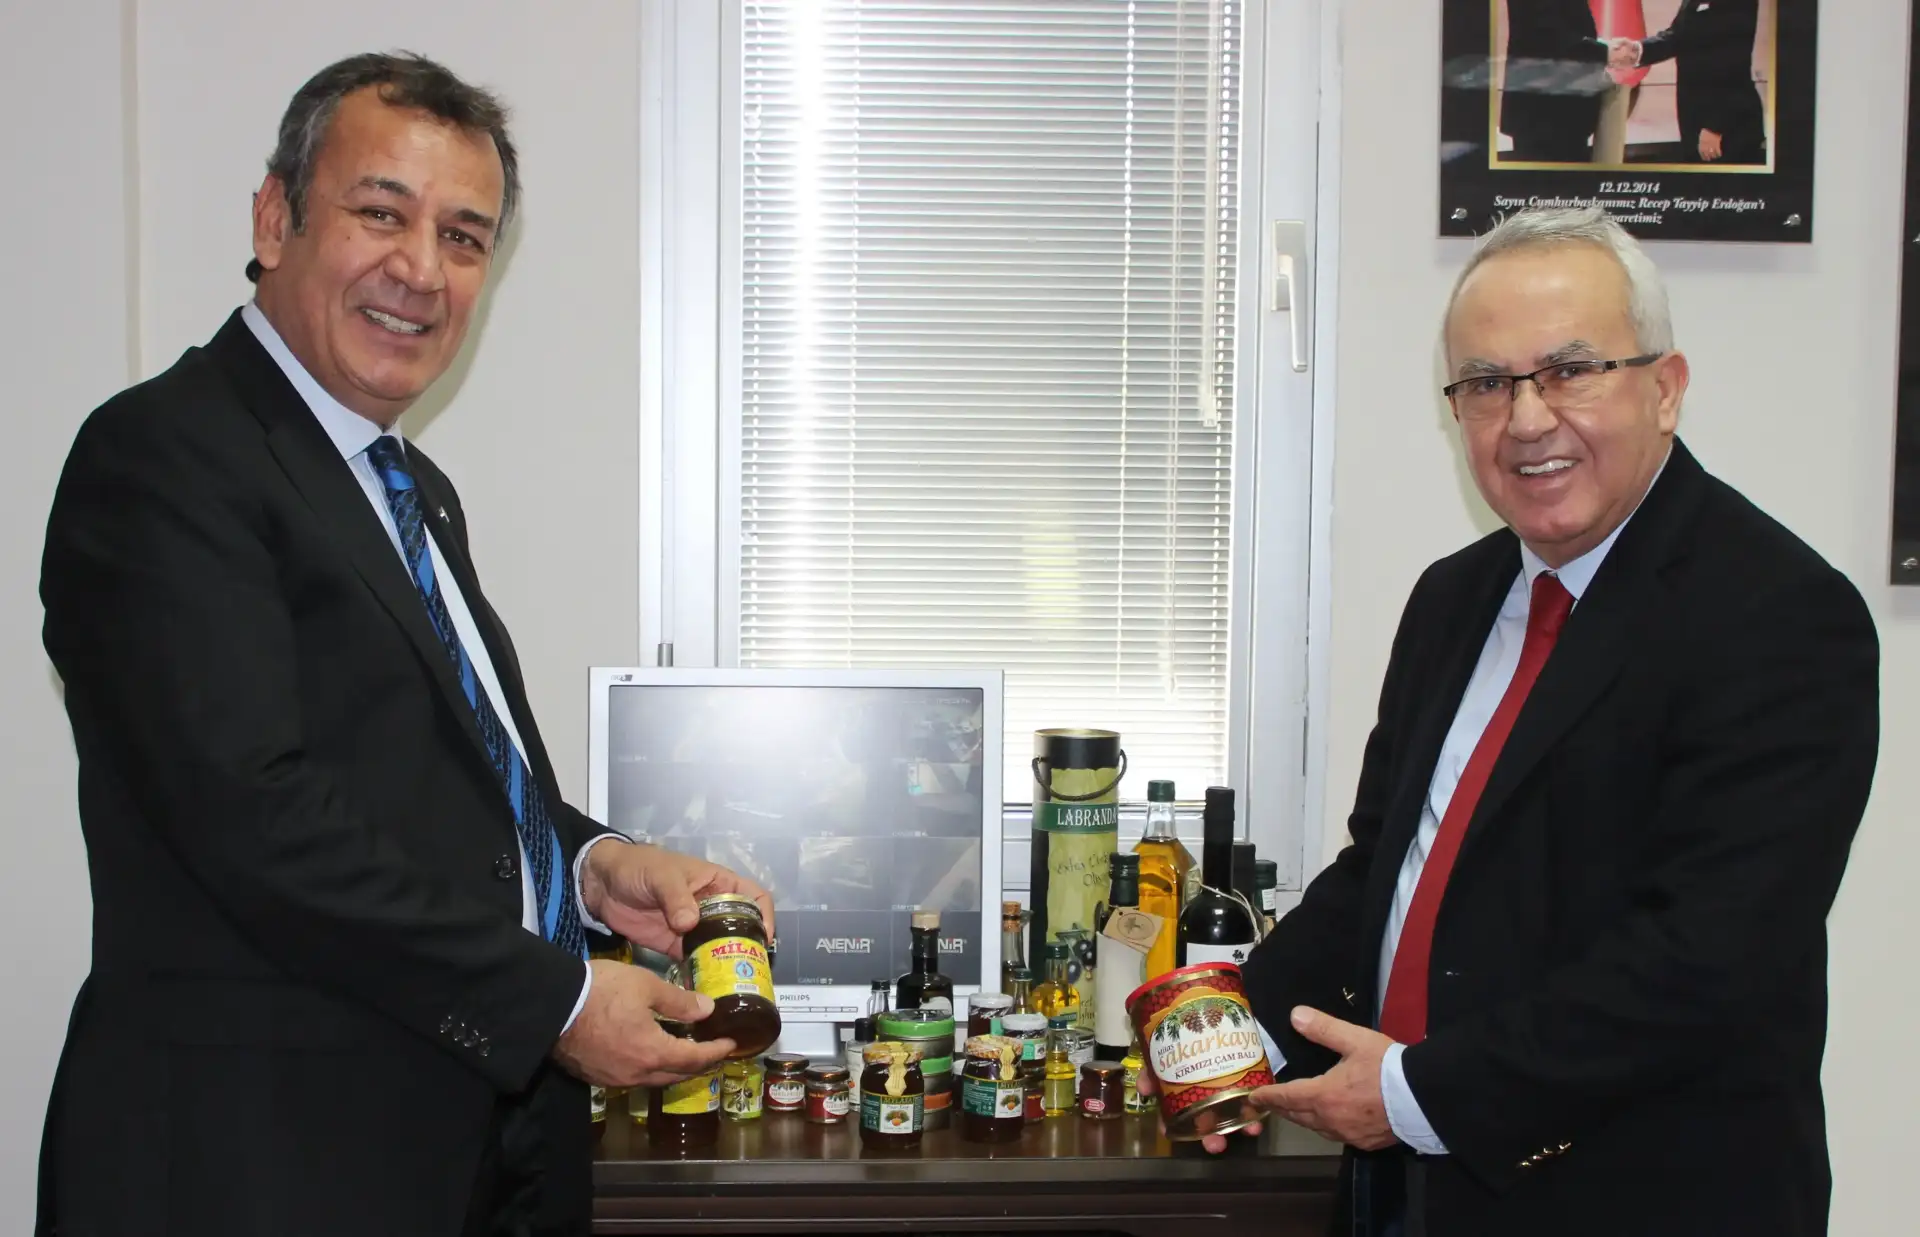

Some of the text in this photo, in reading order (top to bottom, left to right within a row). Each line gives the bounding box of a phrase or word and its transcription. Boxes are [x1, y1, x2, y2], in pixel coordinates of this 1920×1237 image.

[1599, 182, 1660, 193] 12.12.2014
[1493, 195, 1526, 210] Sayın
[1638, 197, 1671, 211] Recep
[1673, 197, 1709, 212] Tayyip
[1056, 807, 1117, 827] LABRANDA
[779, 994, 811, 1002] PHILIPS
[1157, 1044, 1175, 1057] Milas
[1175, 1058, 1213, 1080] KIRMIZI
[1214, 1053, 1237, 1067] ÇAM
[1237, 1051, 1256, 1062] BALI
